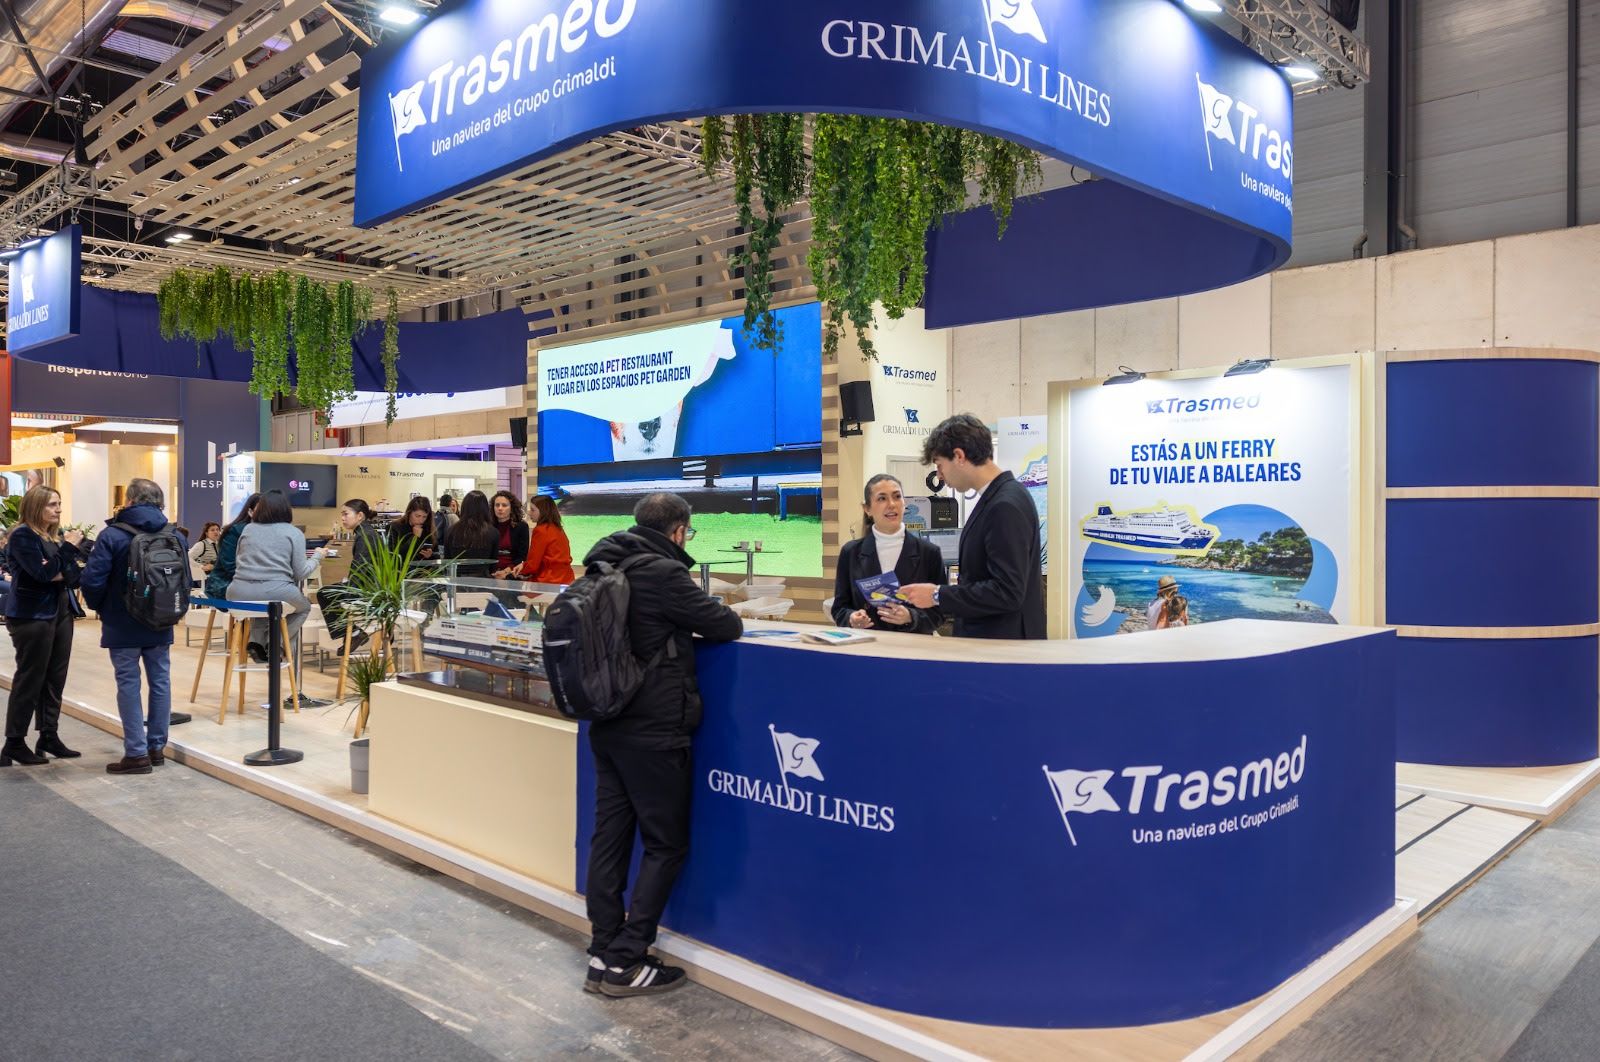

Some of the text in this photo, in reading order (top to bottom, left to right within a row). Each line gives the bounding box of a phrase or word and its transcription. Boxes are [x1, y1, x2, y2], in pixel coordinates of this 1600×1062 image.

[821, 19, 1111, 127] GRIMALDI LINES
[432, 56, 616, 156] Una naviera del Grupo Grimaldi
[1236, 101, 1293, 184] Tras
[1241, 171, 1258, 192] Una
[1259, 182, 1285, 205] naviera
[32, 304, 49, 325] LINES
[547, 350, 673, 382] TENER ACCESO A PET RESTAURANT
[547, 365, 691, 396] Y JUGAR EN LOS ESPACIOS PET GARDEN
[893, 366, 936, 381] Trasmed
[1166, 393, 1262, 414] Trasmed
[883, 424, 917, 435] GRIMALDI
[1131, 438, 1276, 462] ESTÁS A UN FERRY
[191, 480, 223, 488] HESP
[1110, 462, 1301, 485] DE TU VIAJE A BALEARES
[1121, 734, 1307, 814] Trasmed
[708, 769, 895, 833] GRIMALDI LINES
[1132, 795, 1299, 844] Una naviera del Grupo Grimaldi
